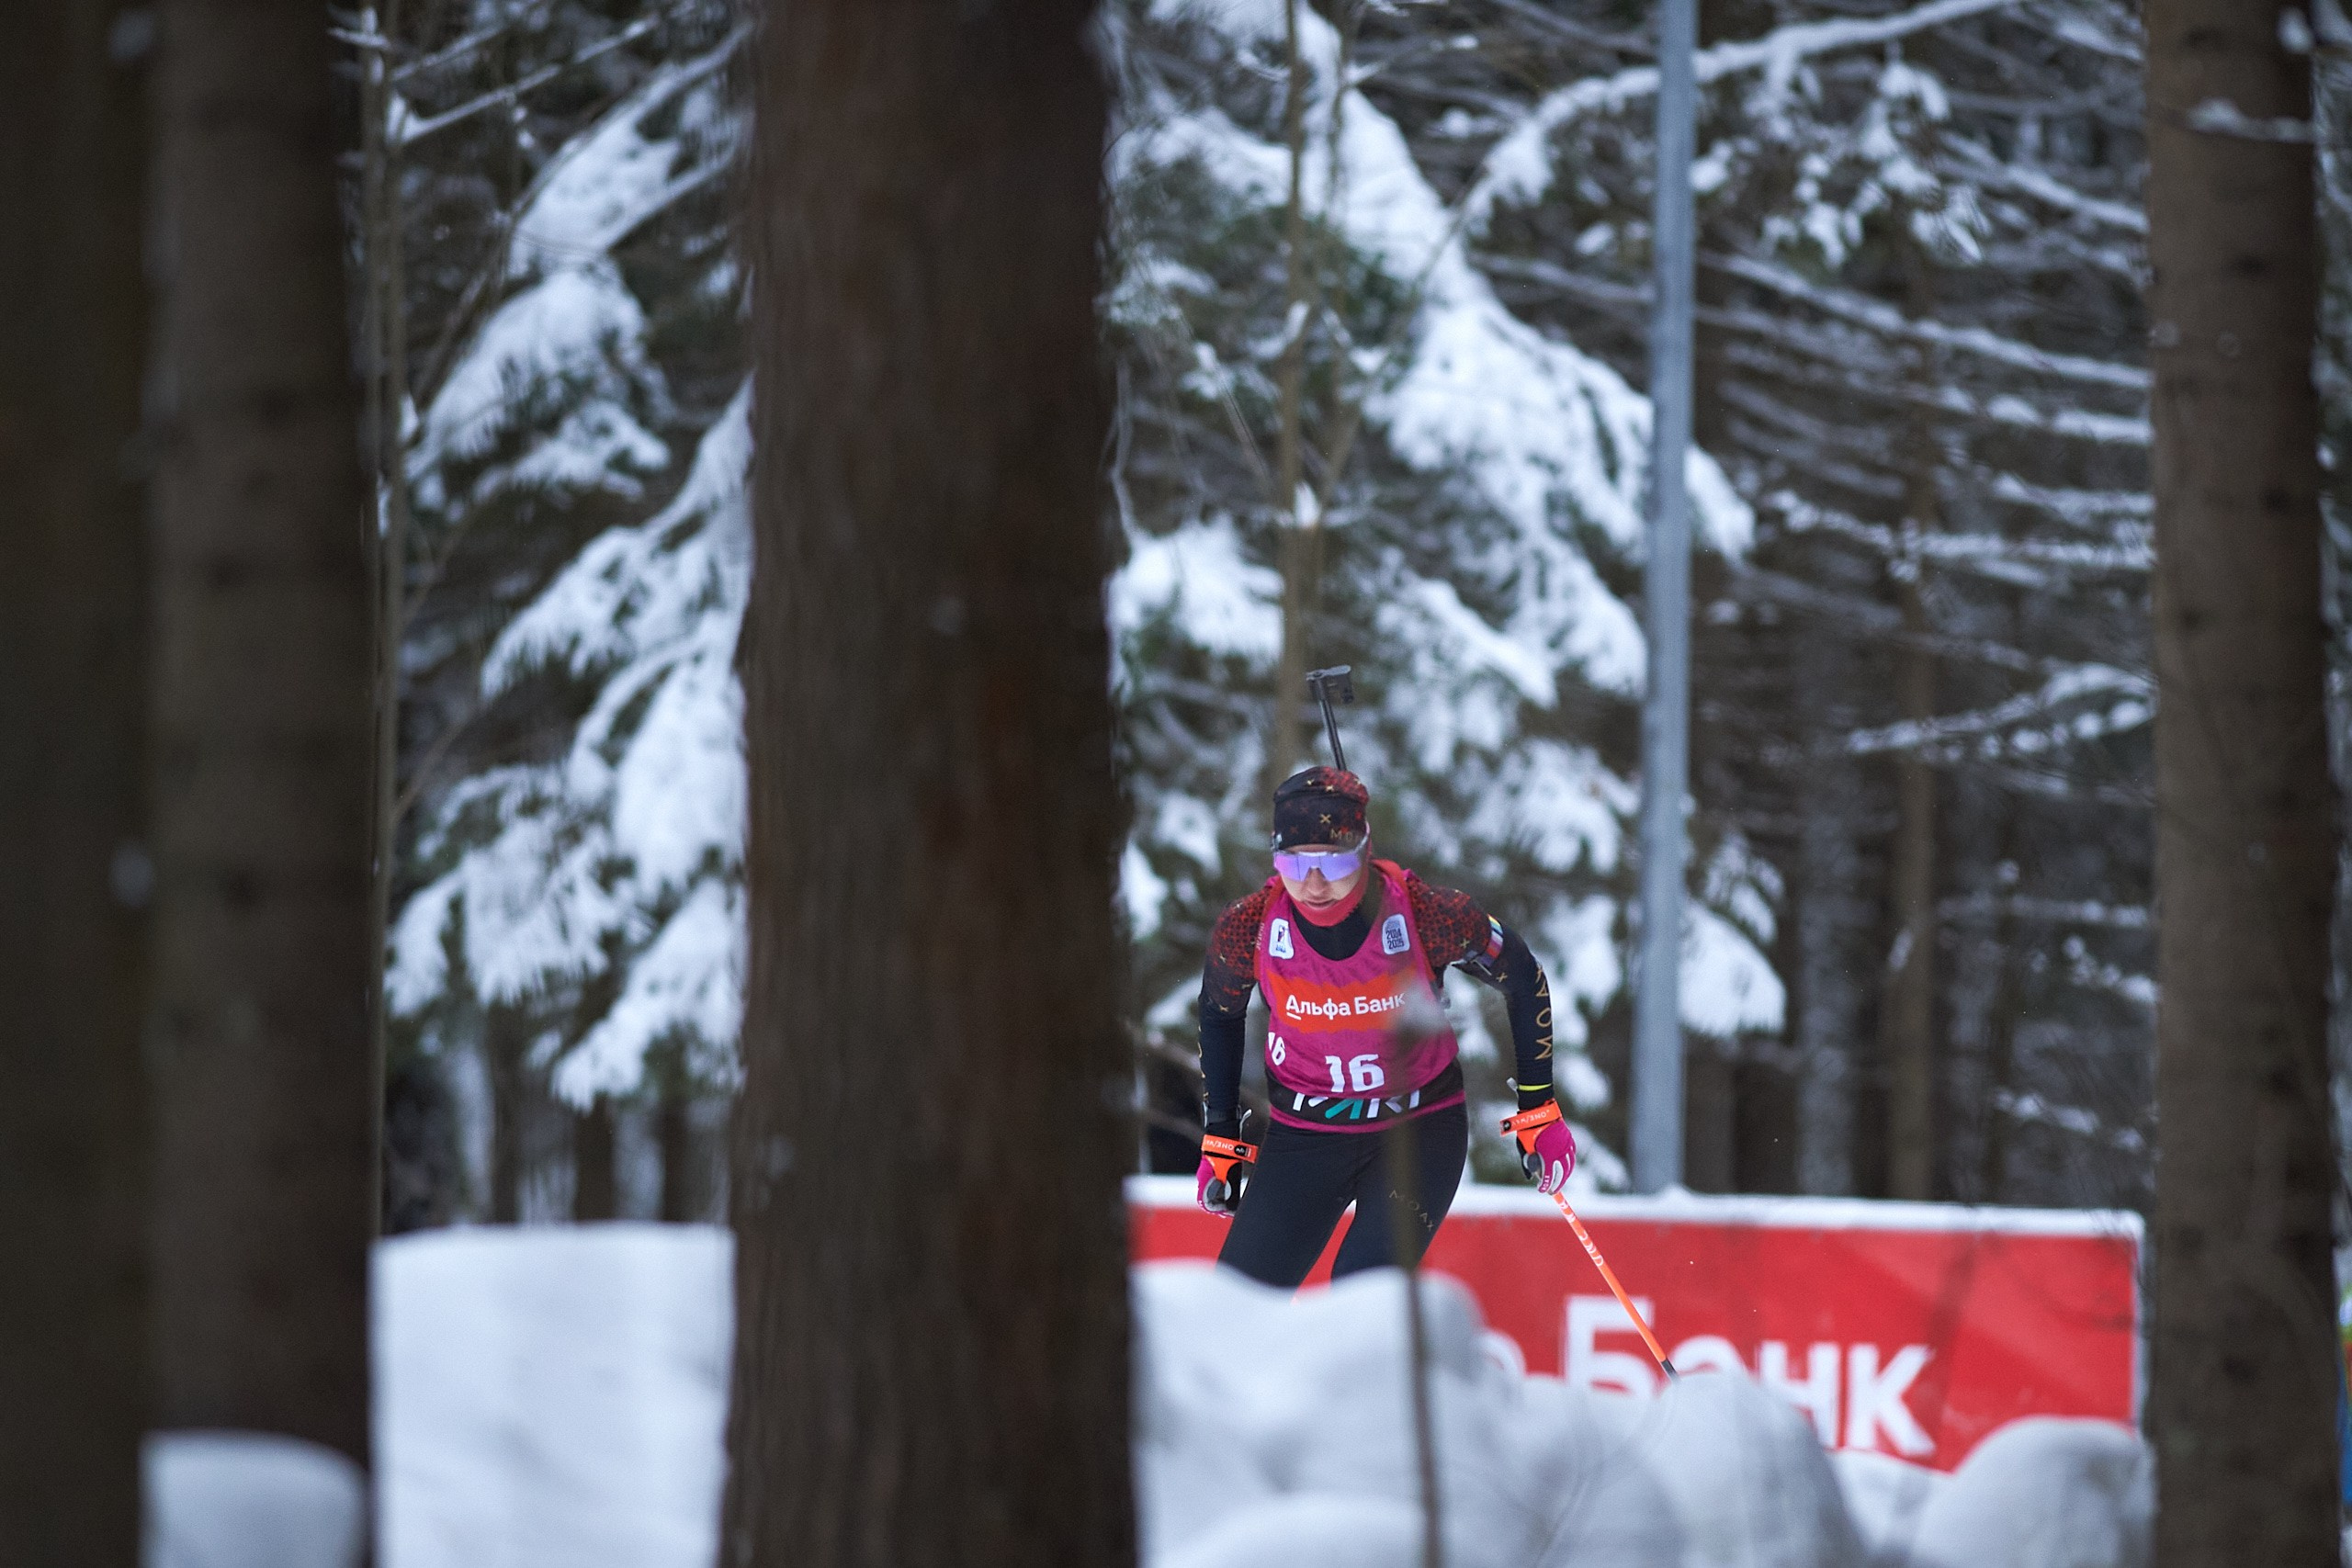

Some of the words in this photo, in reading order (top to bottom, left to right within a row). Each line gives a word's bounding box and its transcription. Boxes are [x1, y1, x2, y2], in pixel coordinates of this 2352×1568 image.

[1286, 994, 1351, 1020] Альфа
[1355, 992, 1406, 1015] Банк
[1325, 1054, 1385, 1093] 16
